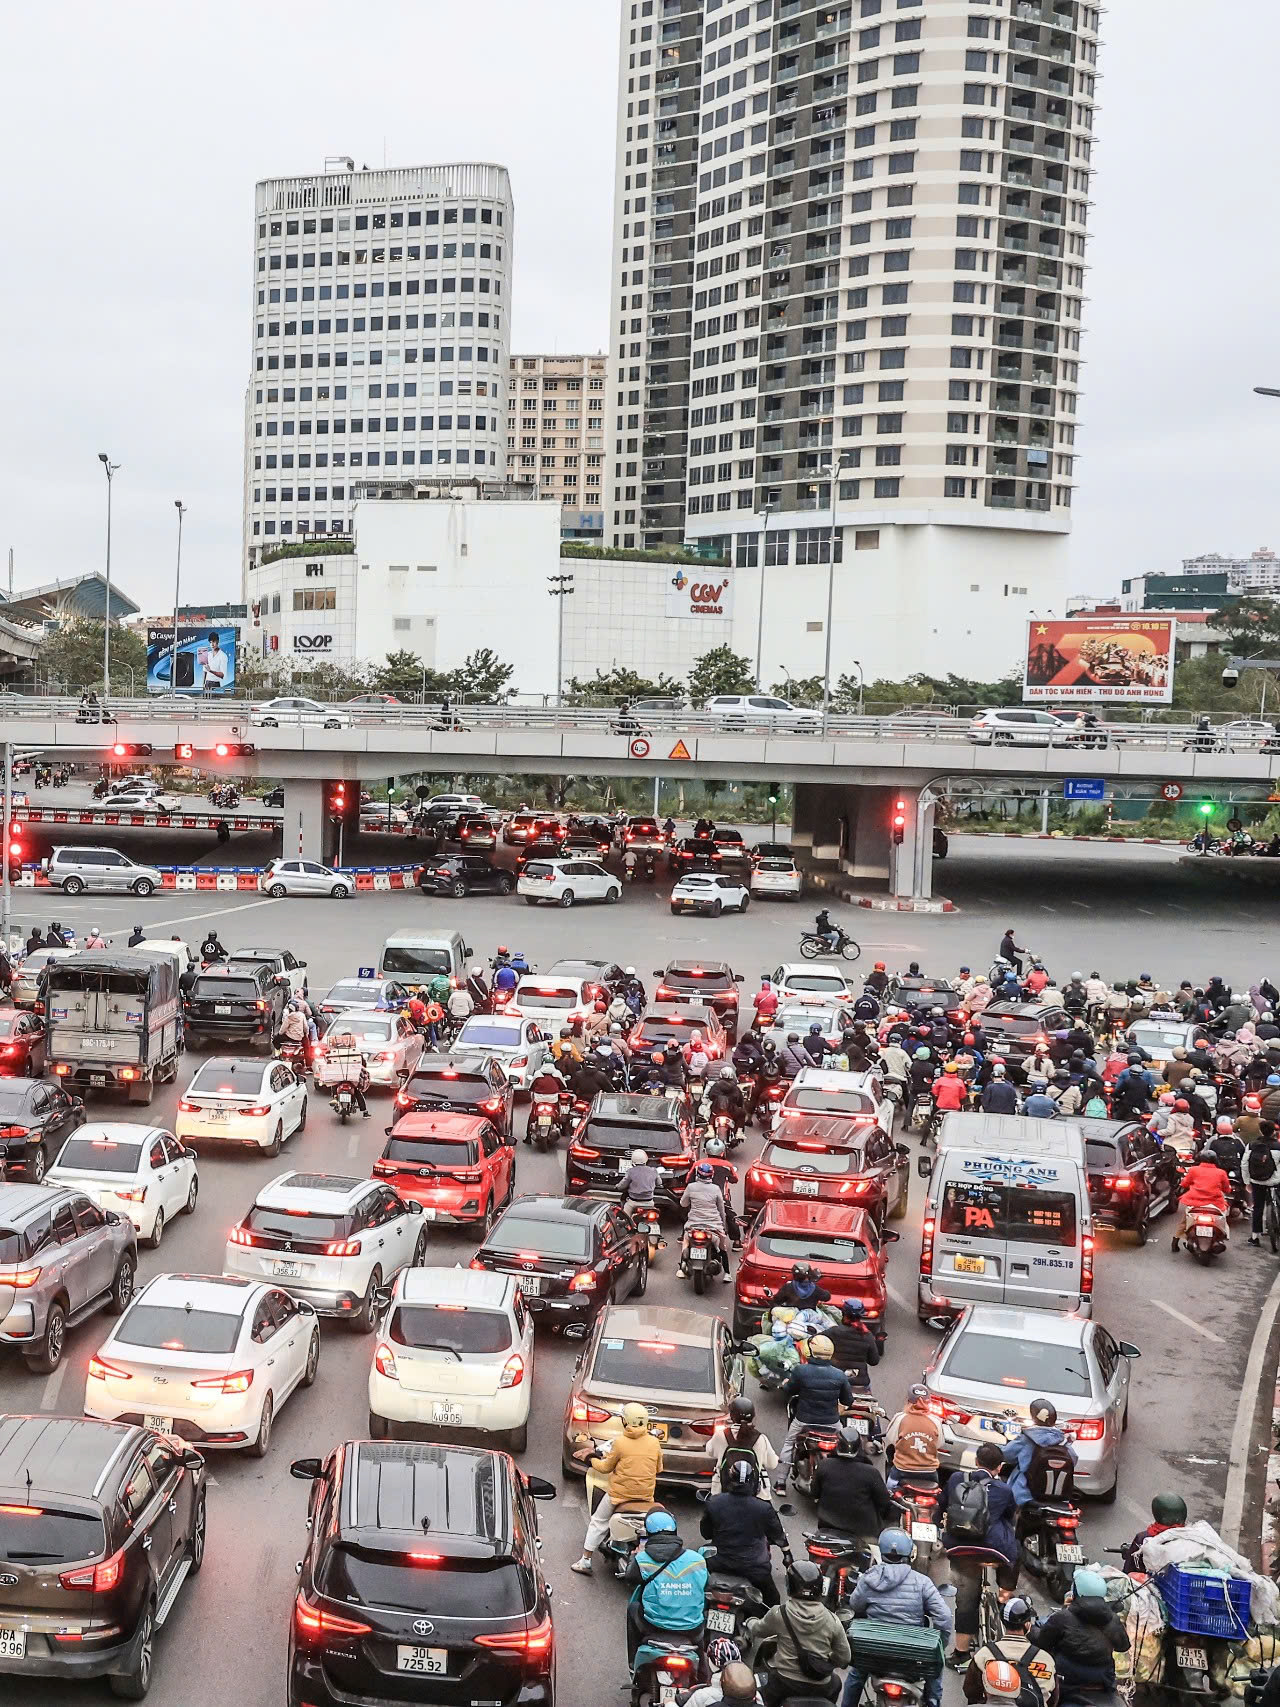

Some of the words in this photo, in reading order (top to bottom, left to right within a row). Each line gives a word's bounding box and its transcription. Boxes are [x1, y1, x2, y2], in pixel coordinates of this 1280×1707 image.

[690, 583, 723, 603] CGV
[690, 605, 723, 615] CINEMAS
[293, 635, 332, 648] LOOP
[1026, 1167, 1058, 1178] ANH
[964, 1207, 995, 1229] PA
[412, 1647, 433, 1660] 30L
[402, 1658, 441, 1672] 725.92
